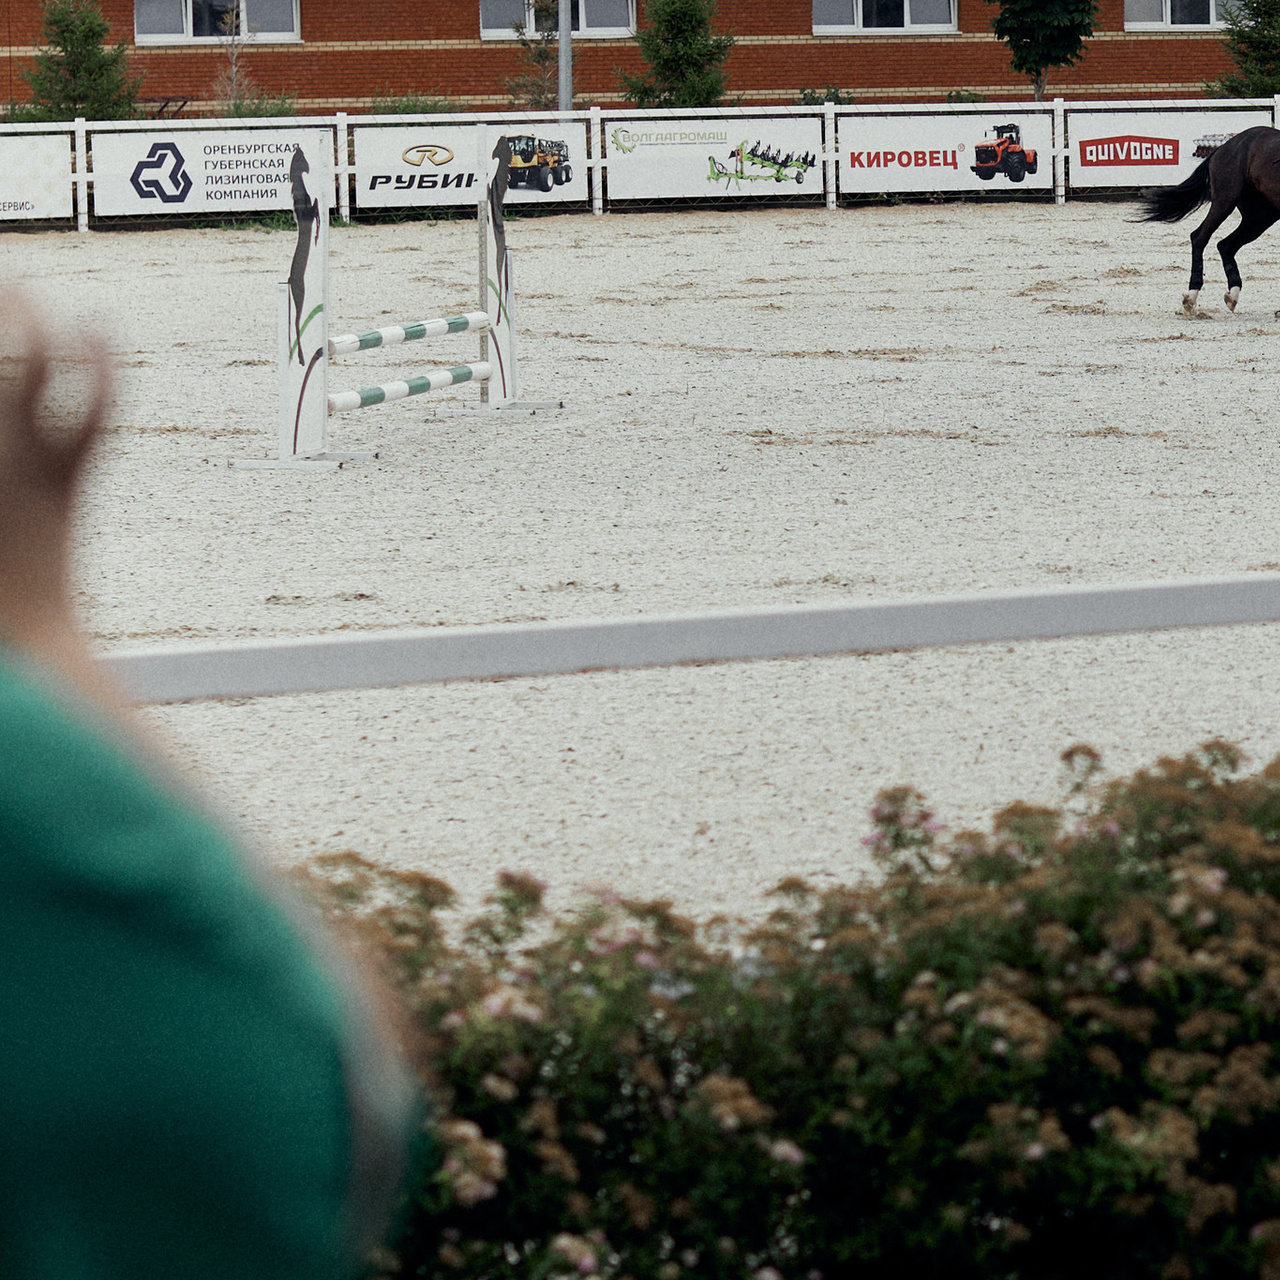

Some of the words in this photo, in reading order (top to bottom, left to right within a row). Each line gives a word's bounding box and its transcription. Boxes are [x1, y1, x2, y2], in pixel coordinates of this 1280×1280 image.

[622, 132, 727, 143] ВОЛГААГРОМАШ
[203, 143, 300, 155] ОРЕНБУРГСКАЯ
[1086, 141, 1174, 162] QUIVOGNE
[204, 159, 285, 170] ГУБЕРНСКАЯ
[850, 150, 958, 169] КИРОВЕЦ
[205, 174, 290, 185] ЛИЗИНГОВАЯ
[206, 189, 278, 200] КОМПАНИЯ
